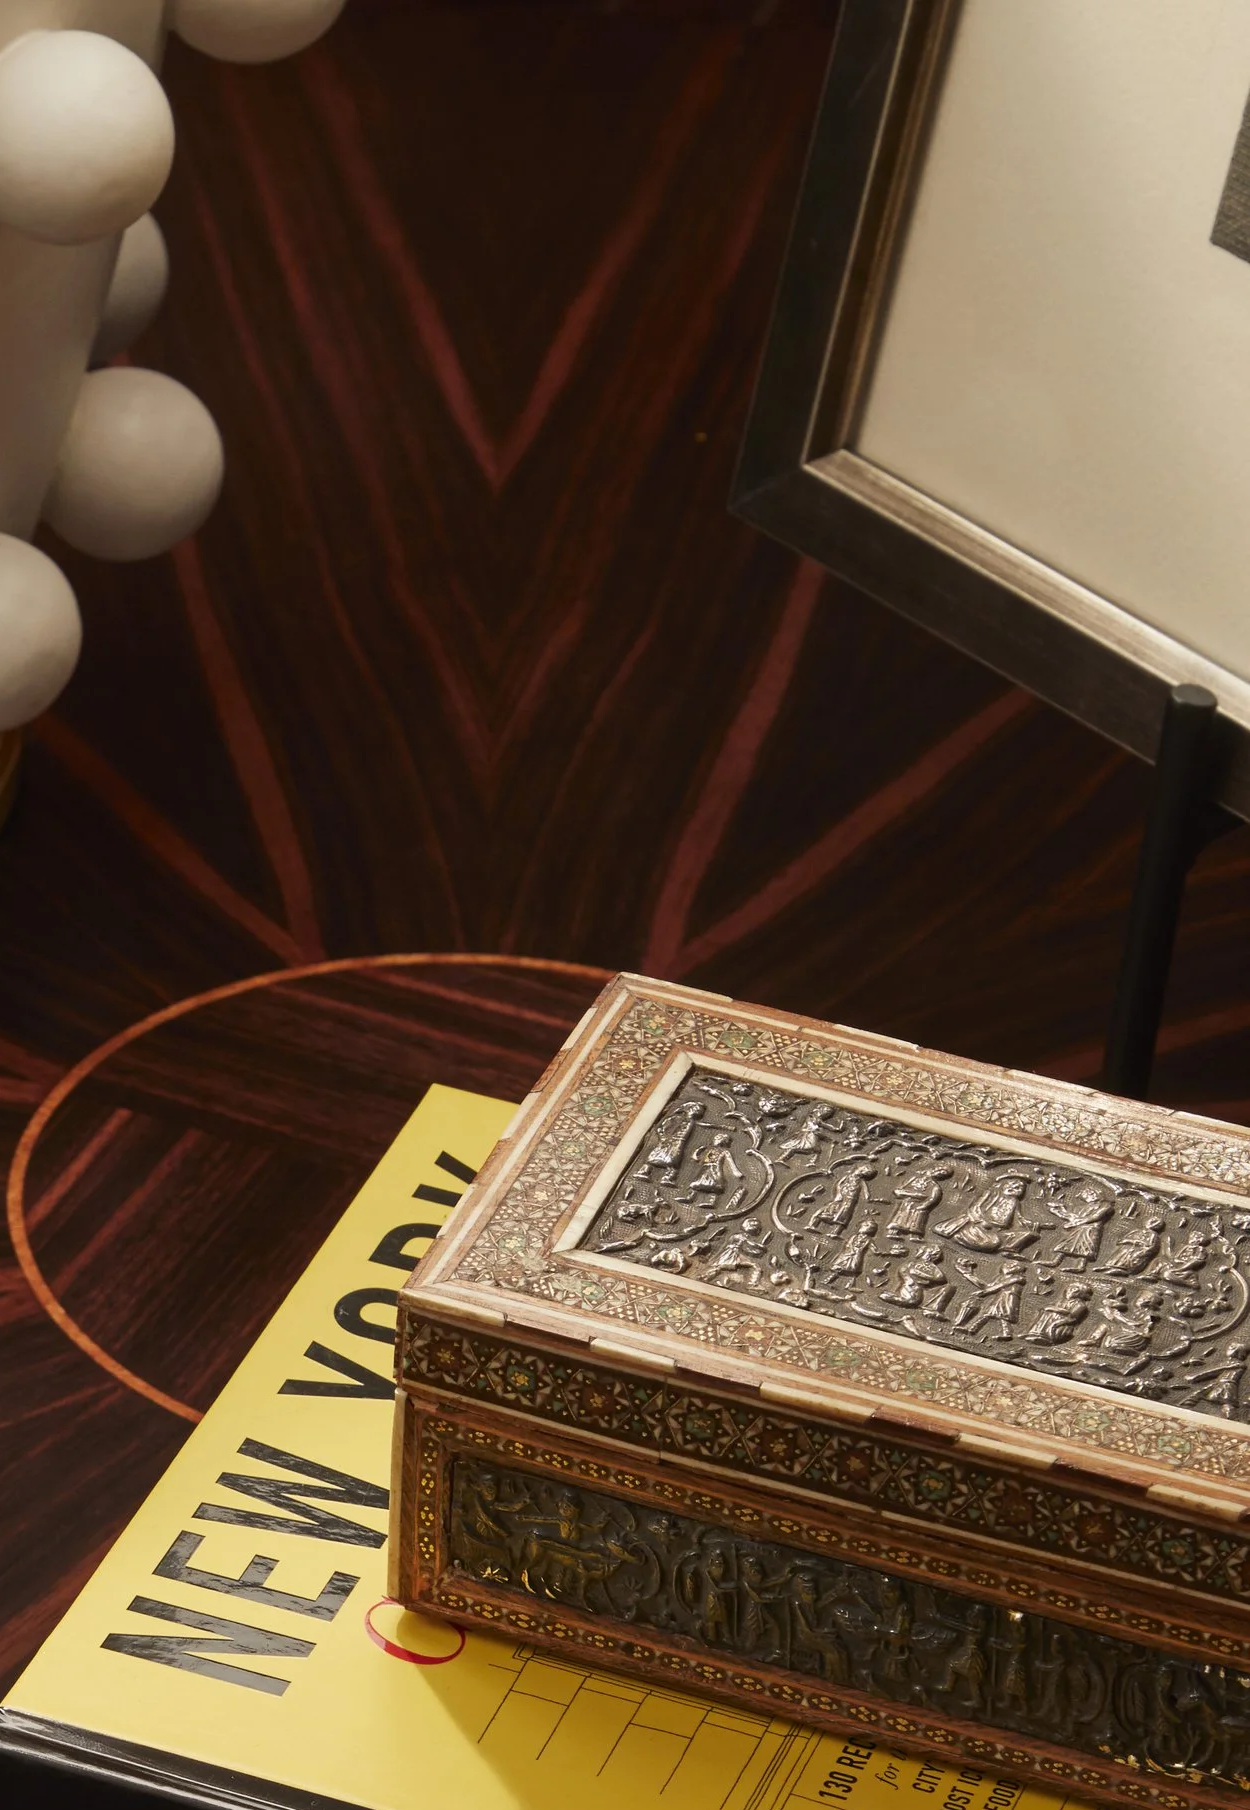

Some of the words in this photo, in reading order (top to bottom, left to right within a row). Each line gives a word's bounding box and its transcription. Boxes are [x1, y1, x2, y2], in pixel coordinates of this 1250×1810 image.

[100, 1437, 390, 1697] NEW
[818, 1770, 858, 1801] 130
[874, 1762, 900, 1791] for
